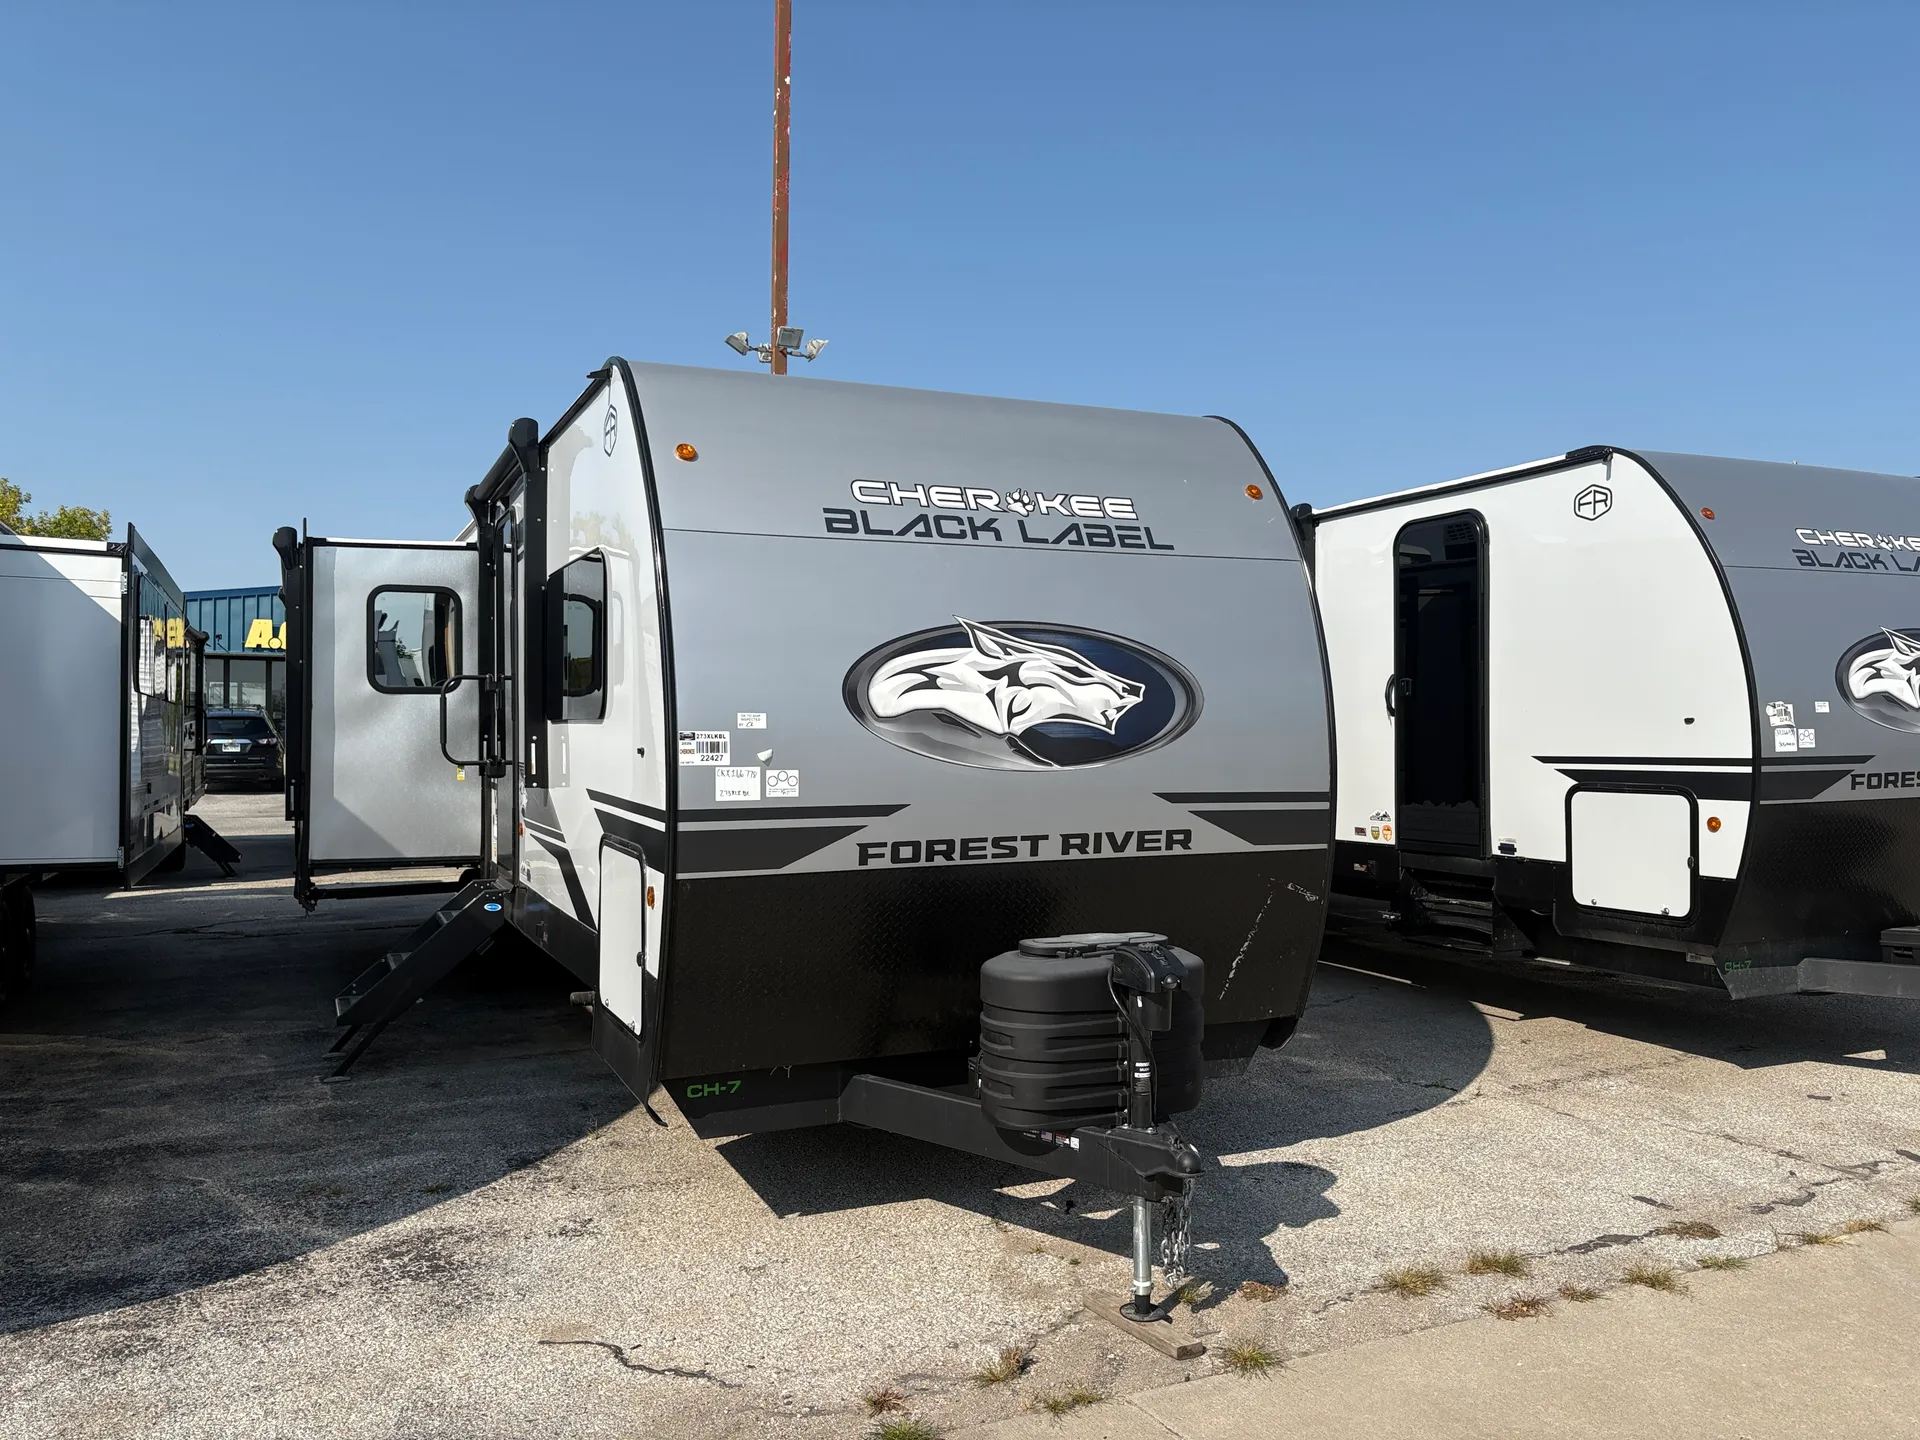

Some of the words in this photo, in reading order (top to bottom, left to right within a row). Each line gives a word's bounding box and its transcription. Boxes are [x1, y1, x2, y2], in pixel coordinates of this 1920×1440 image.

[822, 507, 1003, 542] BLACK
[1017, 519, 1175, 551] LABEL
[1791, 548, 1889, 571] BLACK
[700, 754, 724, 762] 22427
[1850, 771, 1920, 791] FORE
[856, 834, 1049, 867] FOREST
[1060, 828, 1193, 856] RIVER
[686, 1079, 742, 1099] CH-7
